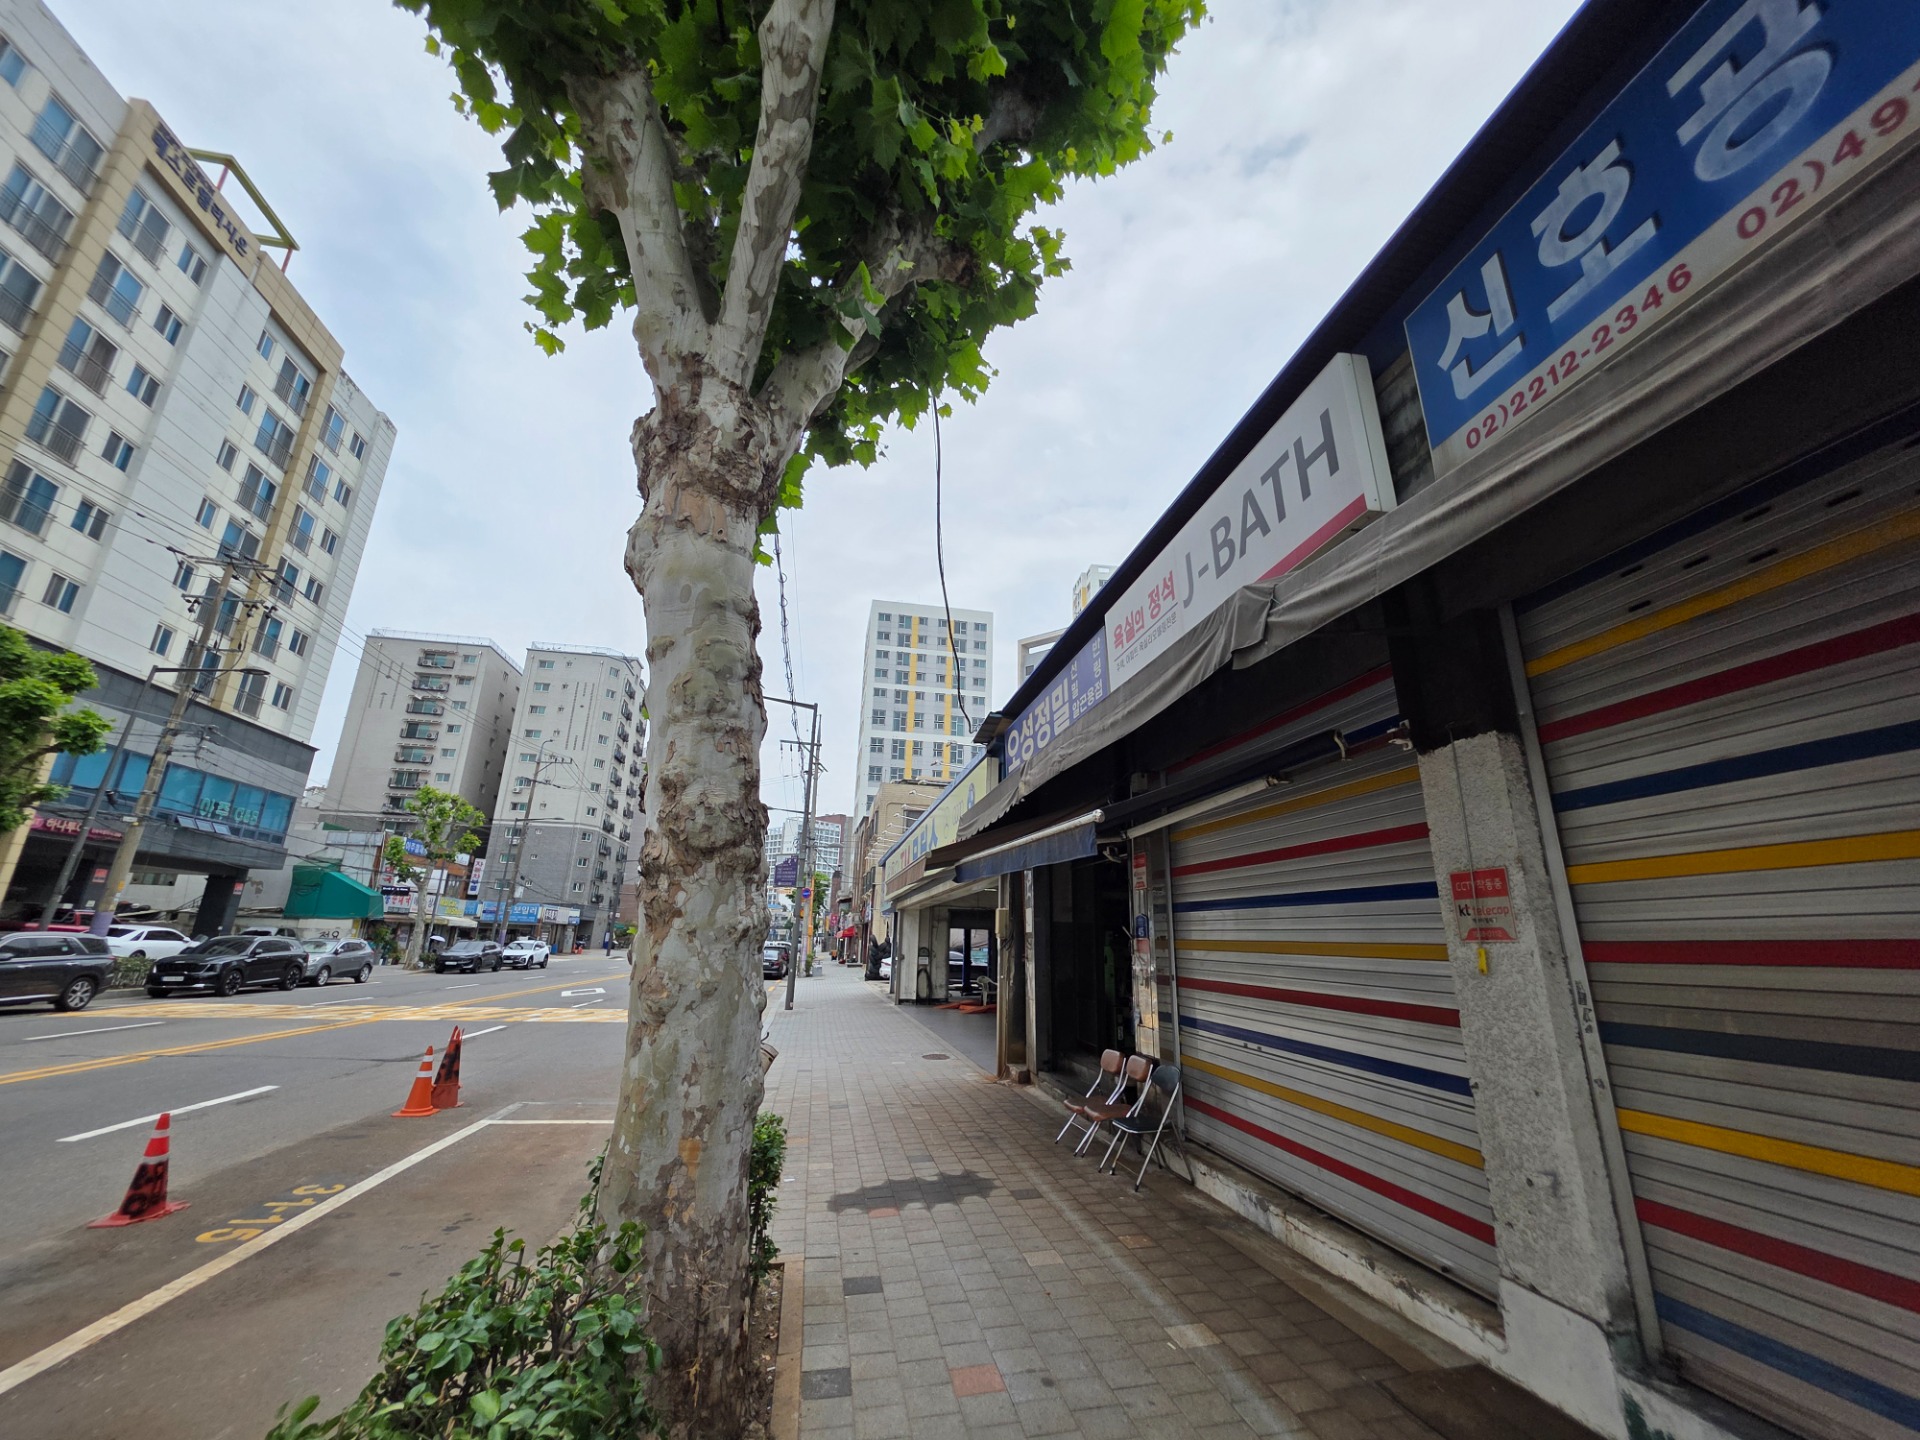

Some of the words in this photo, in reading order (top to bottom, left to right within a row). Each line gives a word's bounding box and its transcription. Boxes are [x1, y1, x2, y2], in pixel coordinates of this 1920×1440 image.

[1465, 262, 1694, 450] 02)2212-2346
[1736, 77, 1920, 241] 02)49
[1183, 407, 1340, 608] J-BATH
[1114, 605, 1145, 650] 욕실의
[1147, 569, 1176, 621] 정석
[1007, 677, 1070, 773] 오성정밀
[512, 905, 538, 915] 보일러
[1459, 904, 1471, 917] kt
